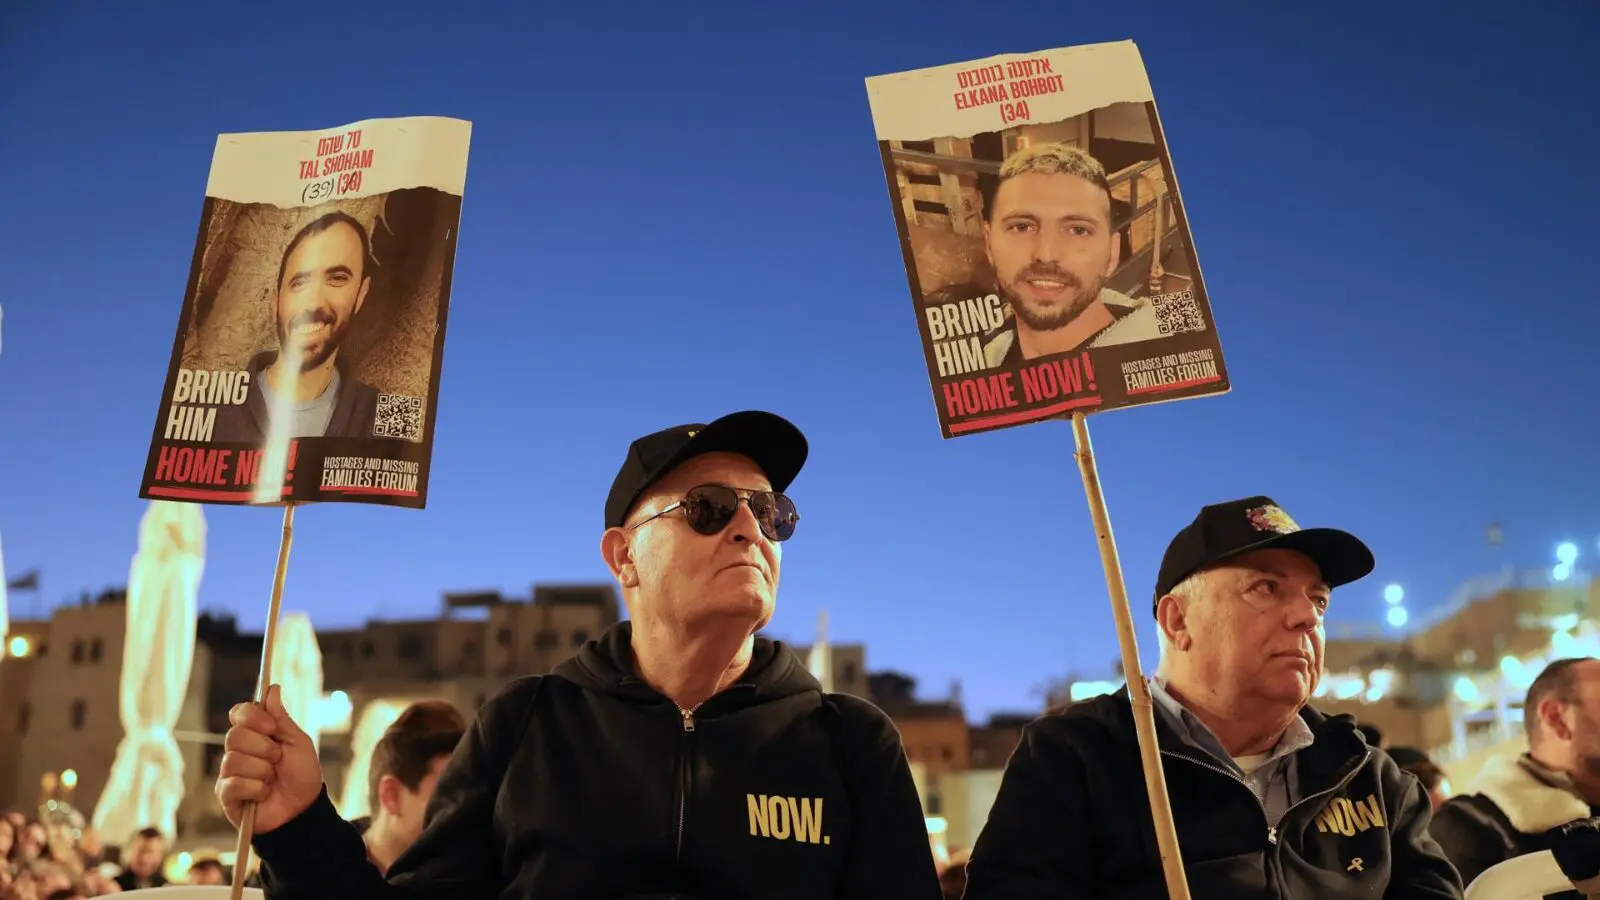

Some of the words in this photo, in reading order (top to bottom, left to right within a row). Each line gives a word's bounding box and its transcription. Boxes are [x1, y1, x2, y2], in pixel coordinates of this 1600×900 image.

[956, 64, 1005, 89] בוחבוט
[1006, 58, 1053, 78] אלקנה
[954, 83, 1010, 110] ELKANA
[1010, 75, 1065, 100] BOHBOT
[1000, 100, 1030, 124] (34)
[316, 135, 344, 157] שהם
[346, 130, 362, 150] טל
[299, 159, 320, 180] TAL
[323, 149, 374, 176] SHOHAM
[301, 178, 335, 204] (39)
[926, 294, 1005, 341] BRING
[933, 336, 986, 377] HIM
[1121, 357, 1162, 374] HOSTAGES
[1162, 354, 1179, 367] AND
[1178, 348, 1214, 364] MISSING
[173, 369, 251, 406] BRING
[942, 372, 1019, 418] HOME
[1019, 351, 1098, 404] NOW!
[1124, 367, 1176, 391] FAMILIES
[1176, 360, 1218, 382] FORUM
[164, 405, 217, 442] HIM
[154, 445, 232, 486] HOME
[321, 469, 373, 488] FAMILIES
[374, 471, 418, 492] FORUM
[323, 456, 363, 469] HOSTAGES
[364, 457, 381, 471] AND
[382, 458, 419, 475] MISSING
[746, 793, 831, 845] NOW.
[1314, 794, 1385, 837] NOW
